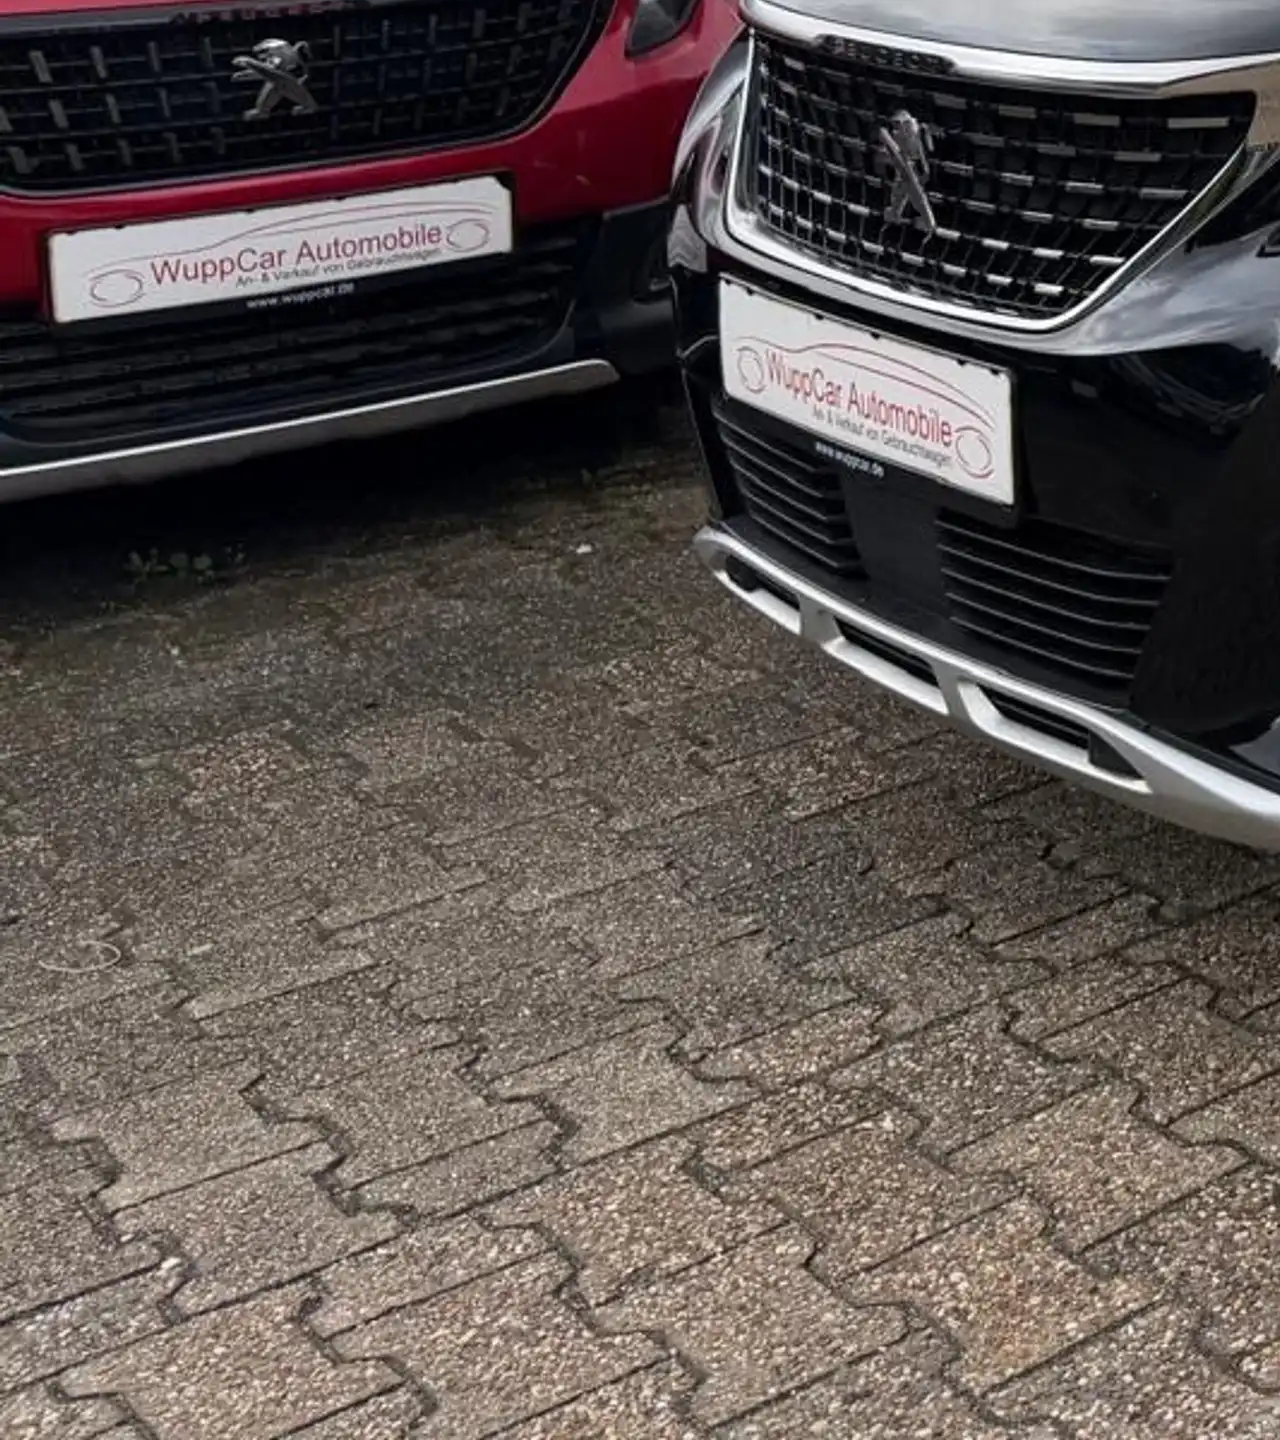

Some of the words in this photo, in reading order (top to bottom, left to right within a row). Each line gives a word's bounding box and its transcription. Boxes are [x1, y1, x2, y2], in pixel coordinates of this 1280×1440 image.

[150, 247, 287, 286] WuppCar
[296, 223, 443, 265] Automobile
[273, 265, 319, 281] Verkauf
[323, 262, 344, 274] von
[764, 346, 842, 407] WuppCar
[847, 382, 953, 446] Automobile
